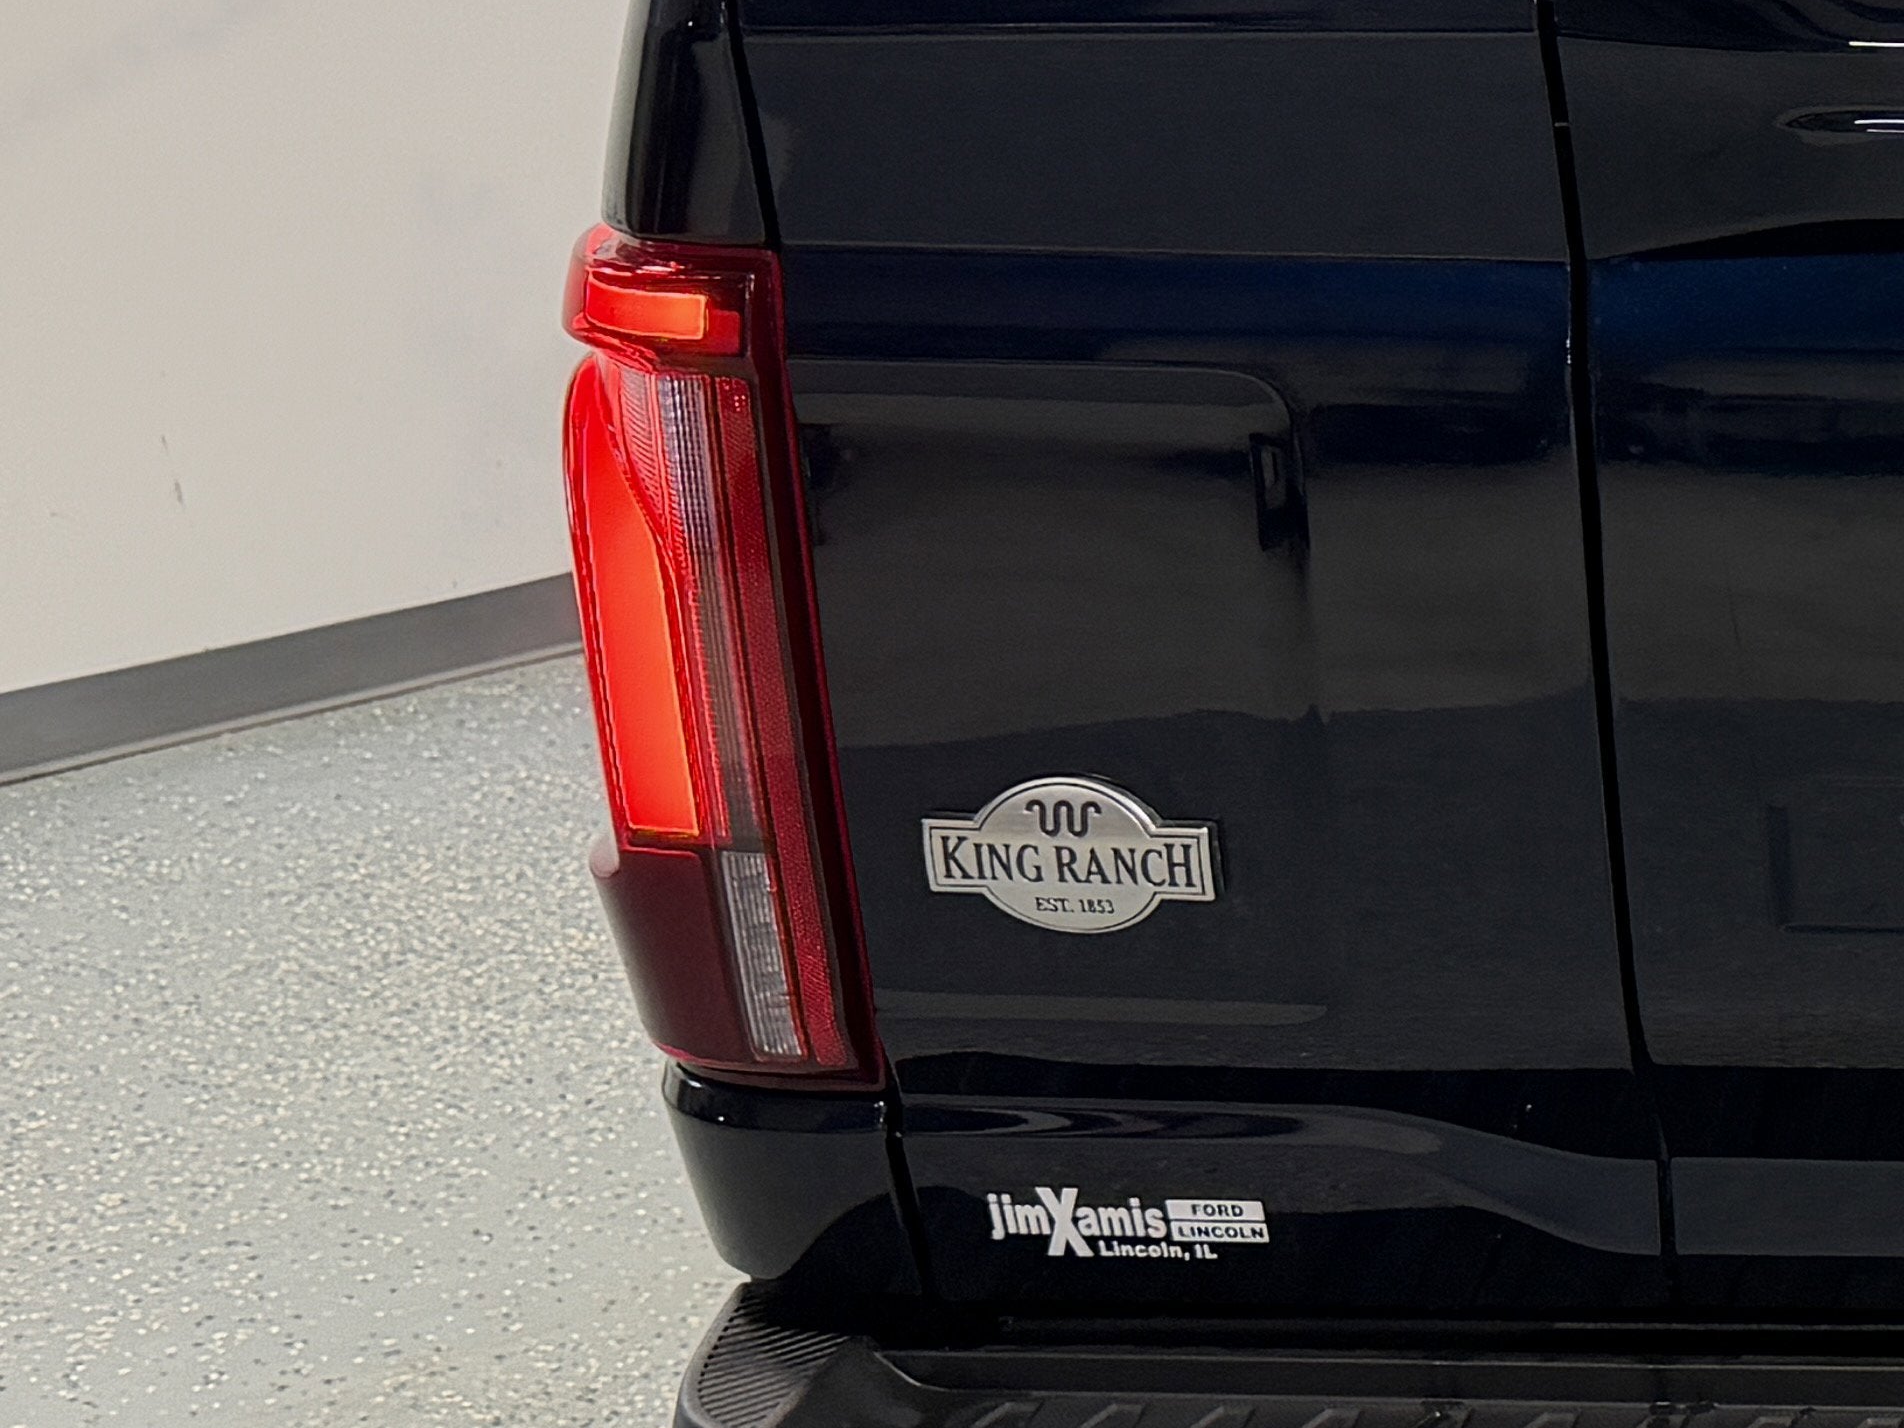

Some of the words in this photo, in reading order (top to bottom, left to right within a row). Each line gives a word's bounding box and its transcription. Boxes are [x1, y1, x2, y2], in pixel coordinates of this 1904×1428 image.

[939, 835, 1045, 884] KING
[1053, 842, 1198, 888] RANCH
[1035, 896, 1075, 914] EST.
[1080, 898, 1115, 914] 1853
[1191, 1203, 1244, 1218] FORD
[1177, 1225, 1264, 1240] LINCOLN
[1098, 1240, 1191, 1262] Lincoln,
